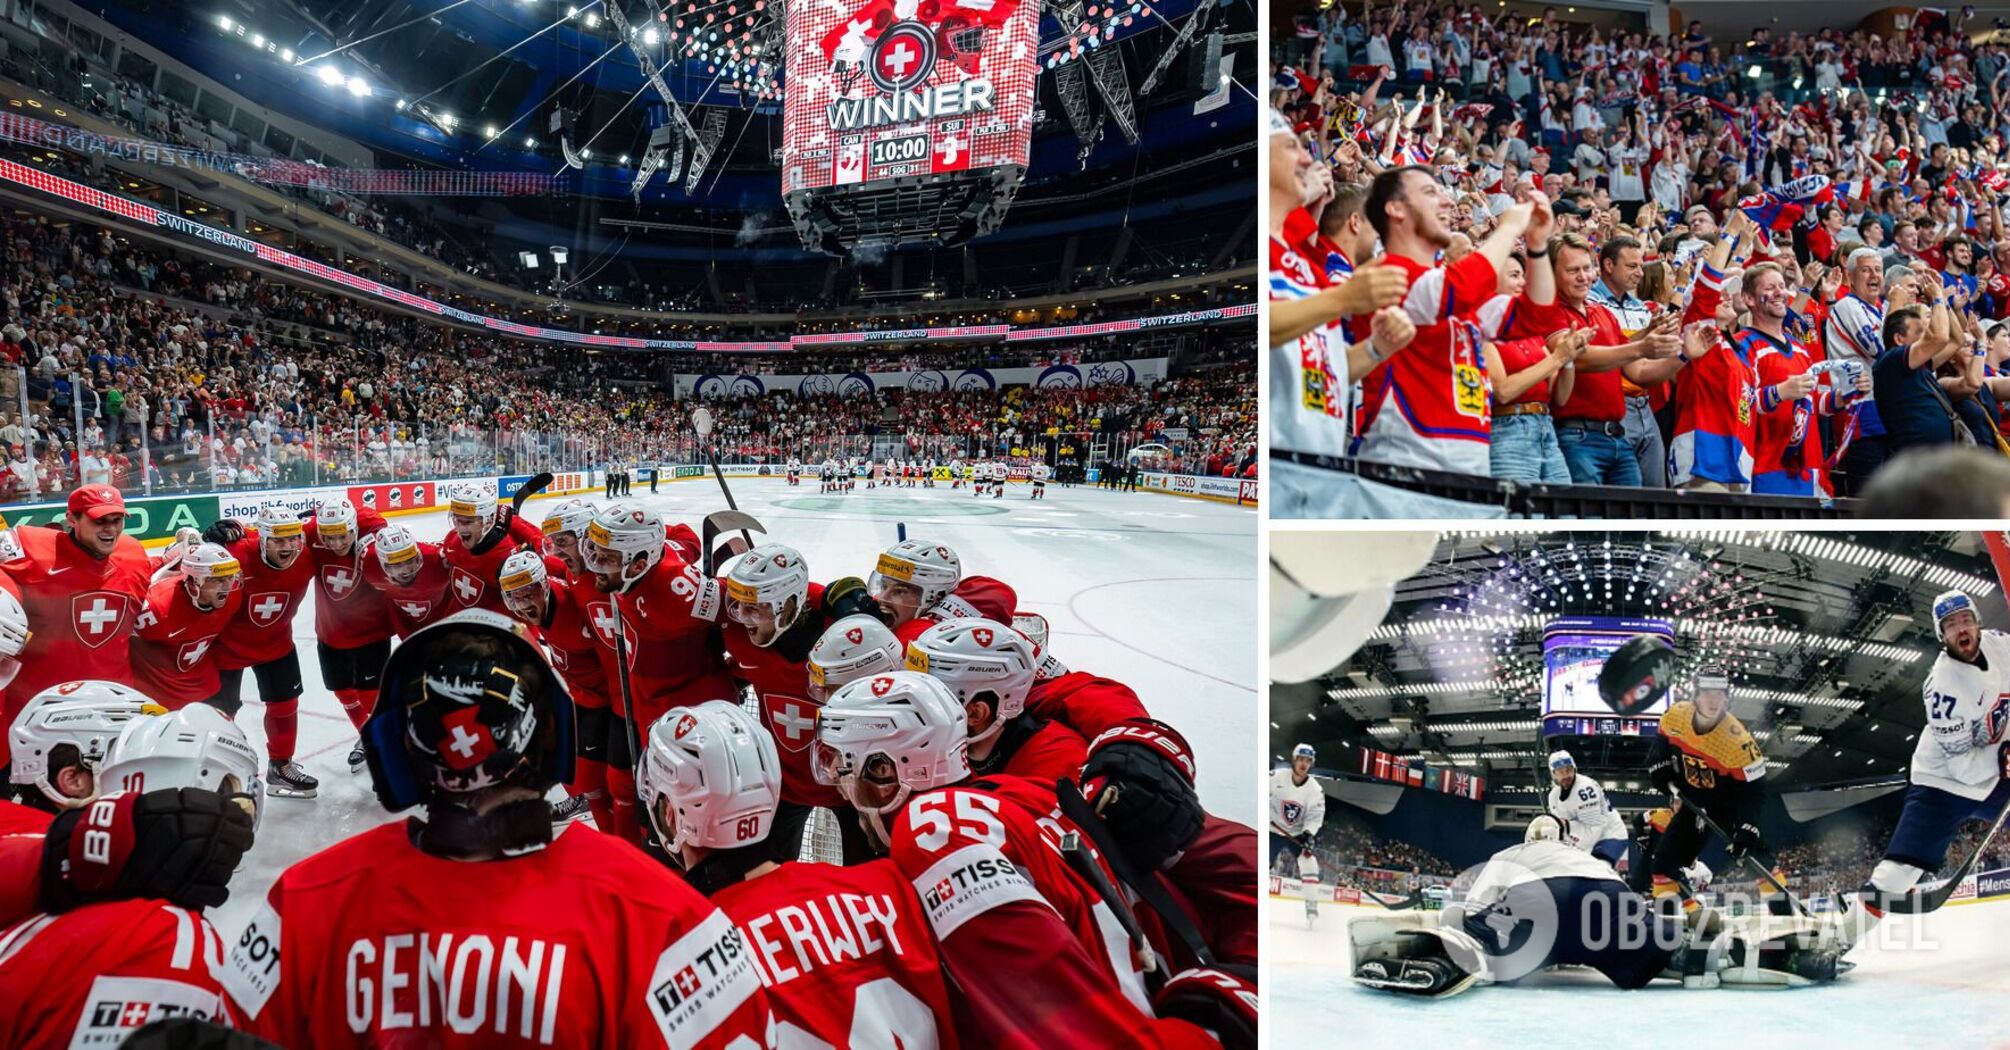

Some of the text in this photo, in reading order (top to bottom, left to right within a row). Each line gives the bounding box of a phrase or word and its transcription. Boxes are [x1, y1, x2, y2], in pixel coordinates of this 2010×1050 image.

[826, 80, 994, 130] WINNER
[946, 121, 961, 132] SUI
[843, 136, 859, 145] CAN
[875, 137, 925, 162] 10:00
[942, 136, 958, 165] 3
[157, 212, 256, 254] SWITZERLAND
[441, 306, 485, 325] SWITZERLAND
[1139, 309, 1223, 328] SWITZERLAND
[645, 340, 696, 350] SWITZERLAND
[864, 329, 928, 341] SWITZERLAND
[1174, 475, 1196, 488] TESCO
[636, 595, 647, 618] C
[1931, 691, 1957, 720] 27
[51, 712, 94, 724] BAUER
[1578, 786, 1597, 801] 62
[736, 816, 759, 842] 60
[908, 790, 1007, 852] 55
[345, 932, 567, 1045] GENONI
[668, 999, 702, 1033] SWISS
